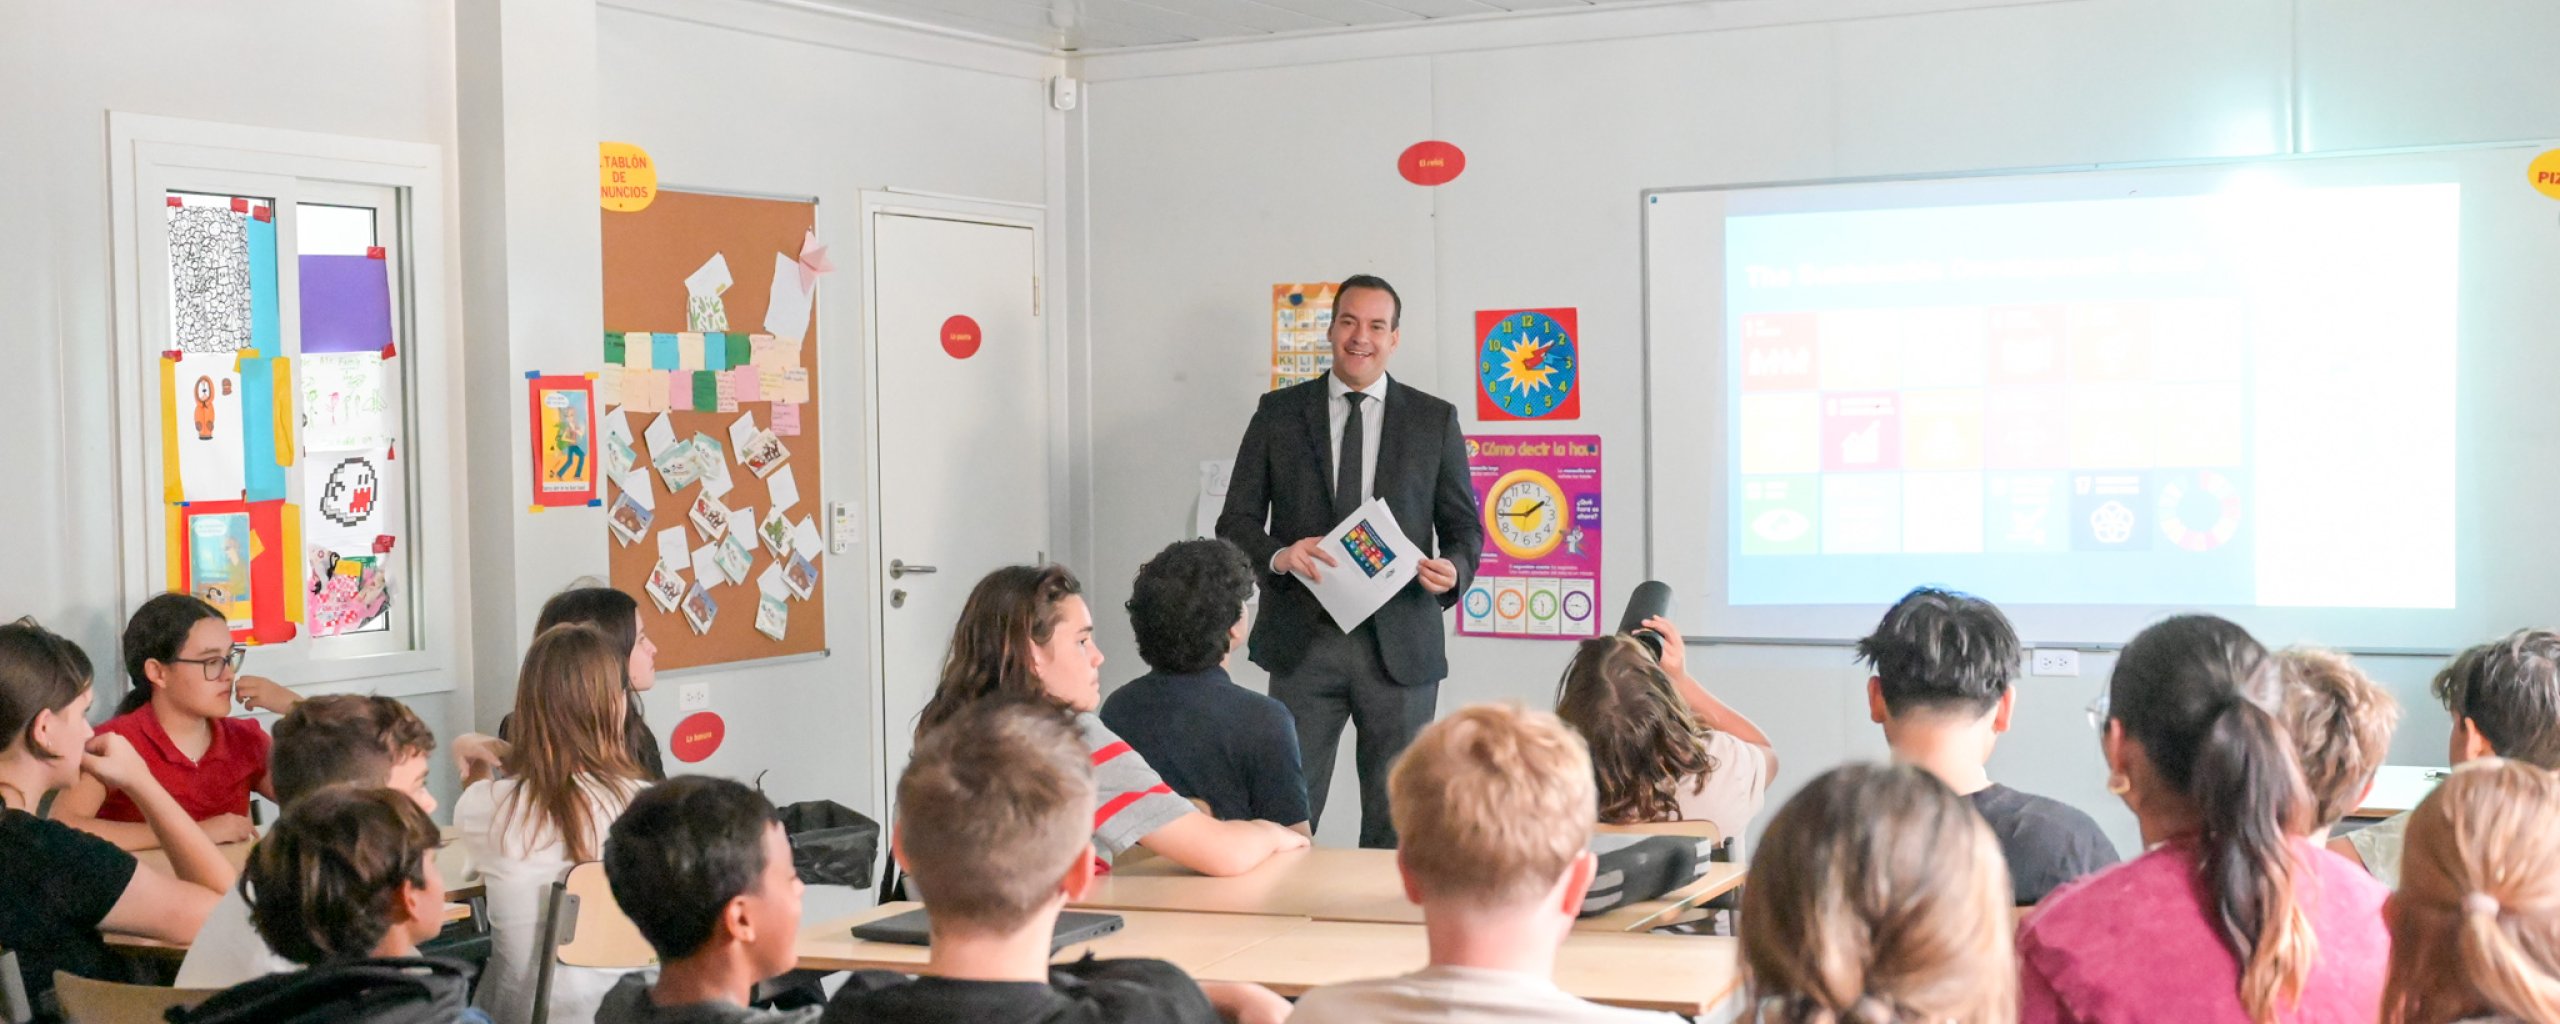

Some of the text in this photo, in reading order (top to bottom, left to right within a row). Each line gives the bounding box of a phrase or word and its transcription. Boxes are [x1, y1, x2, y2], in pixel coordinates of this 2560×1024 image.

[604, 154, 647, 169] TABLÓN
[612, 171, 626, 183] DE
[600, 186, 649, 198] NUNCIOS
[1503, 321, 1513, 333] 11
[1521, 315, 1534, 328] 12
[1544, 321, 1551, 334] 1
[1558, 332, 1566, 346] 2
[1489, 339, 1501, 352] 10
[1482, 361, 1490, 374] 9
[1565, 357, 1573, 369] 3
[1489, 380, 1497, 393] 8
[1558, 380, 1568, 393] 4
[1504, 395, 1512, 408] 7
[1544, 395, 1552, 408] 5
[1524, 403, 1532, 416] 6
[1481, 441, 1516, 457] Cómo
[1519, 441, 1551, 457] decir
[1553, 441, 1566, 457] la
[1511, 487, 1519, 497] 11
[1521, 483, 1531, 494] 12
[1536, 487, 1541, 496] 1
[1502, 496, 1512, 508] 10
[1544, 495, 1551, 507] 2
[1548, 509, 1556, 520] 3
[1502, 522, 1510, 533] 8
[1543, 524, 1551, 534] 4
[1512, 532, 1519, 542] 7
[1523, 535, 1531, 546] 6
[1535, 532, 1542, 543] 5
